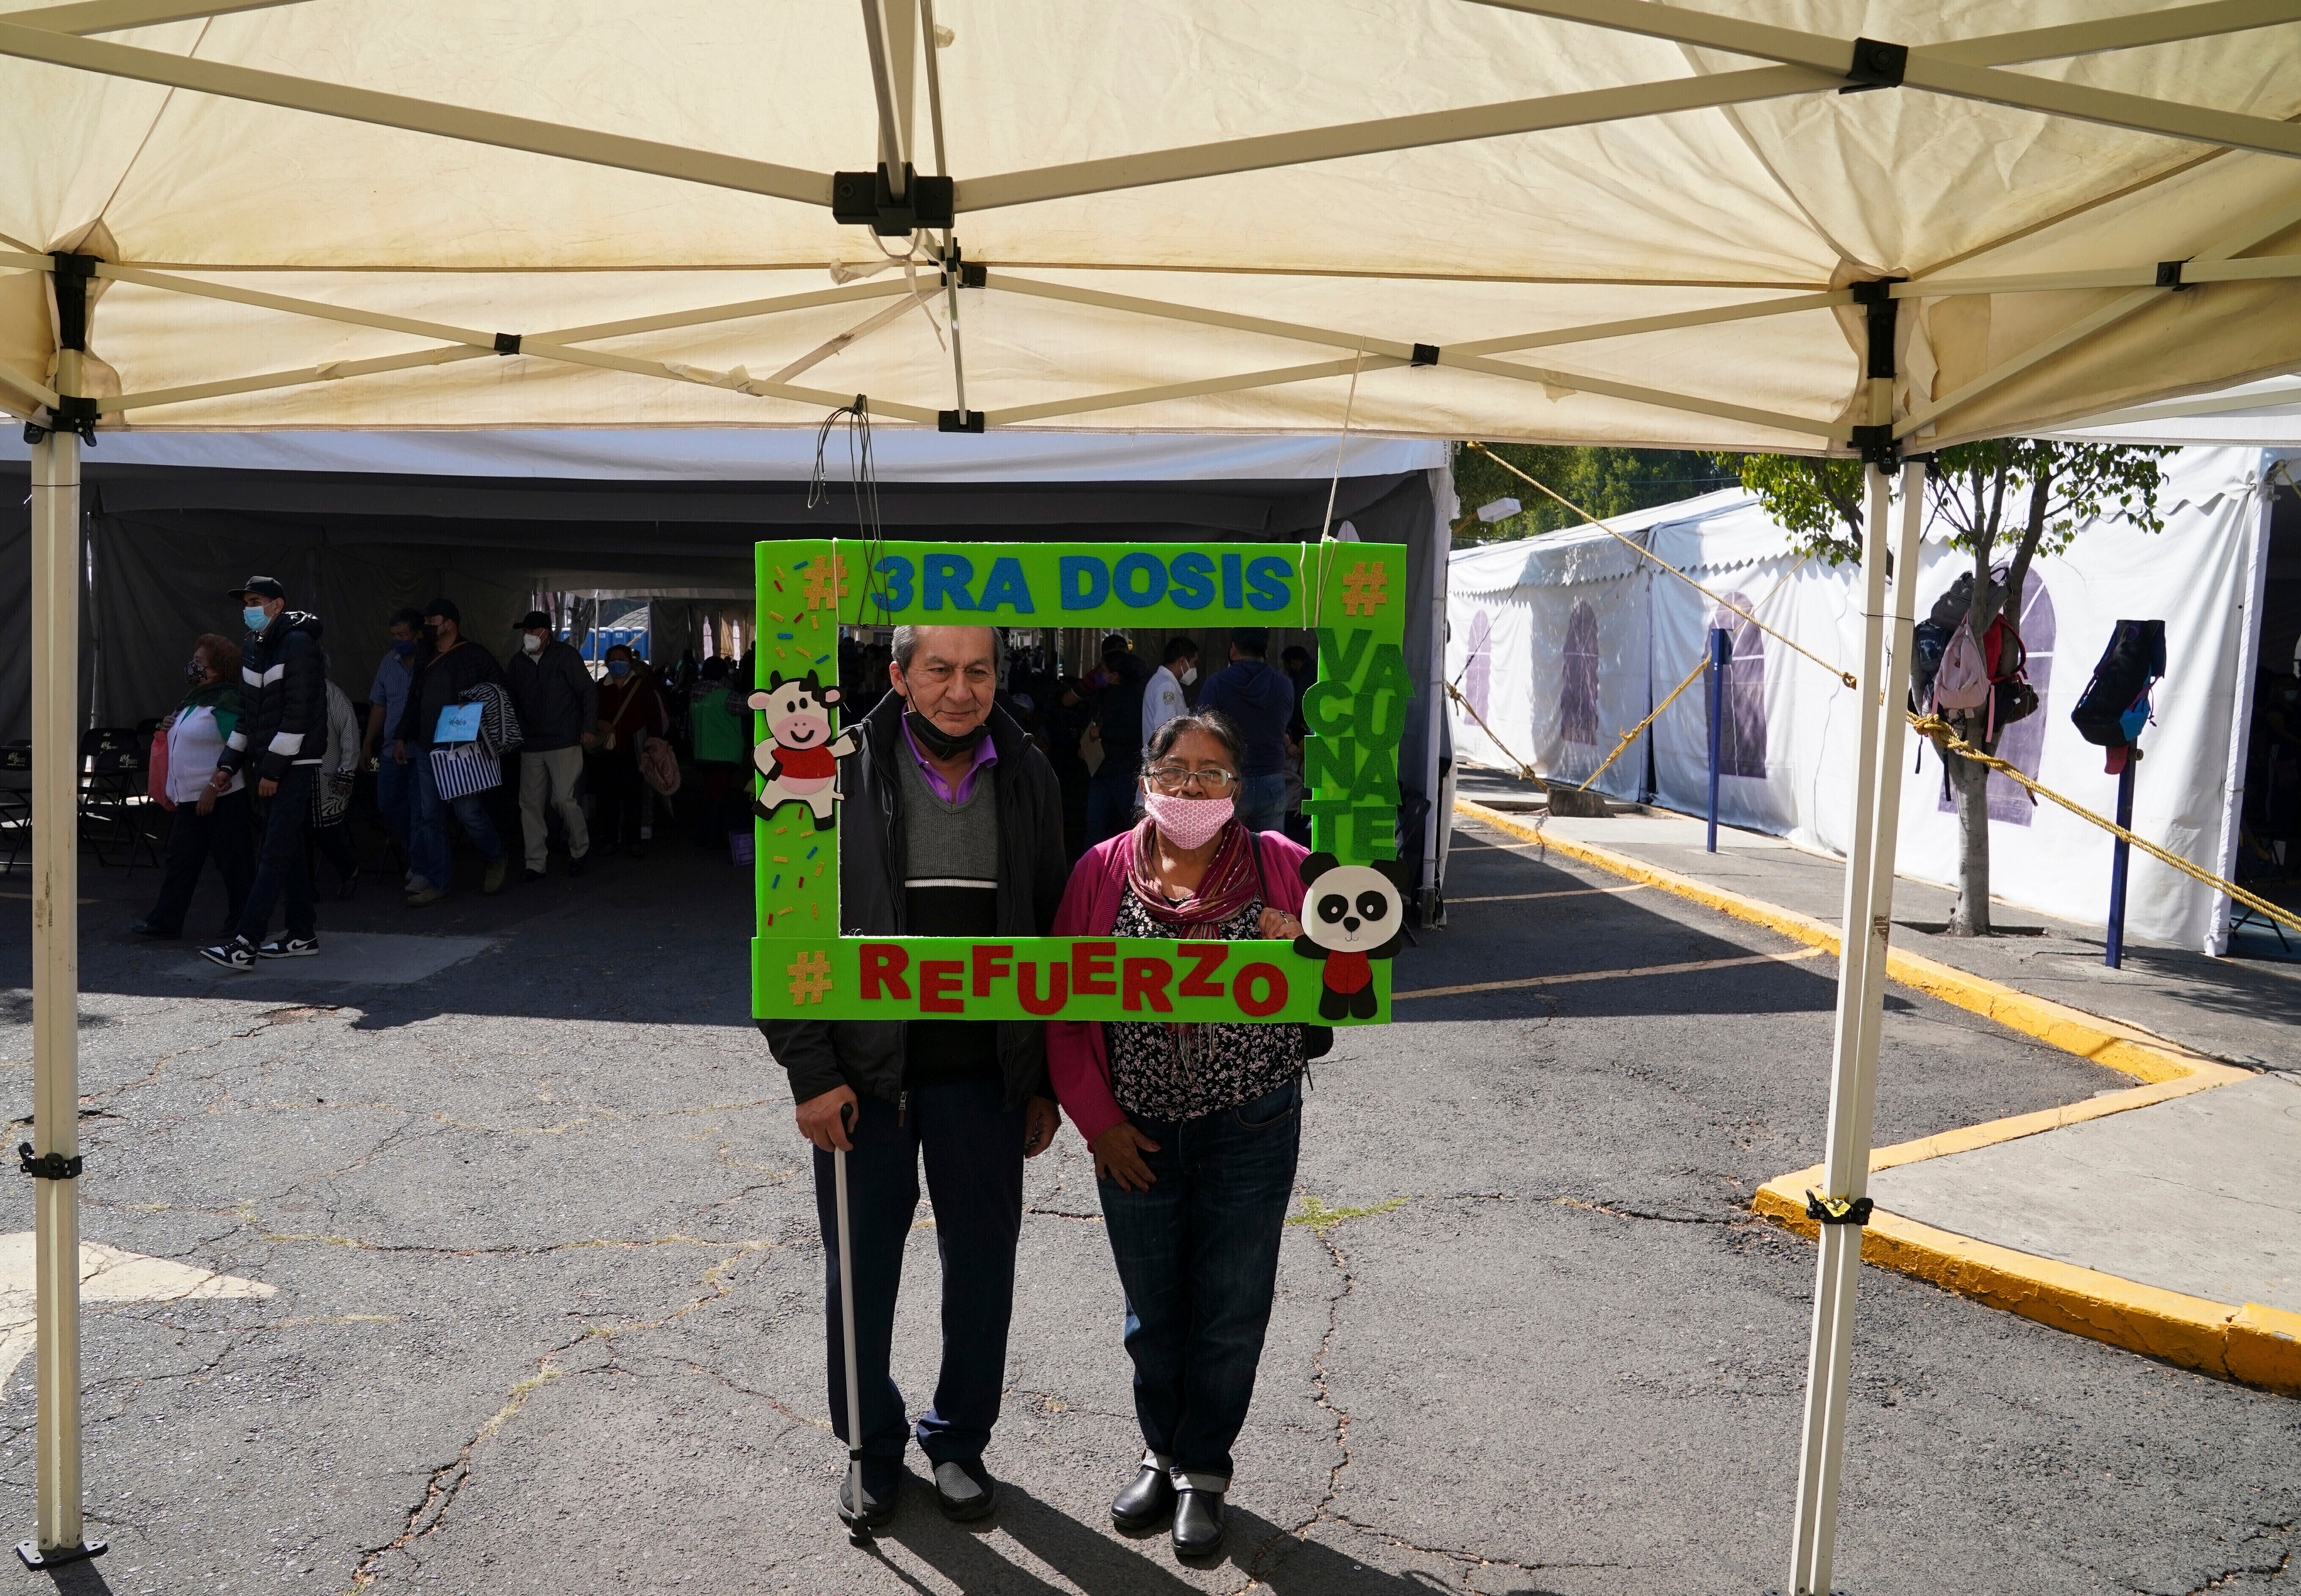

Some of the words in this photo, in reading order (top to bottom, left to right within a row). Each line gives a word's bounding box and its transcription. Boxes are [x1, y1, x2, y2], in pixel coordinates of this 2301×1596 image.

[871, 553, 1035, 613] 3RA
[1060, 552, 1293, 610] DOSIS
[859, 942, 1288, 1017] REFUERZO
